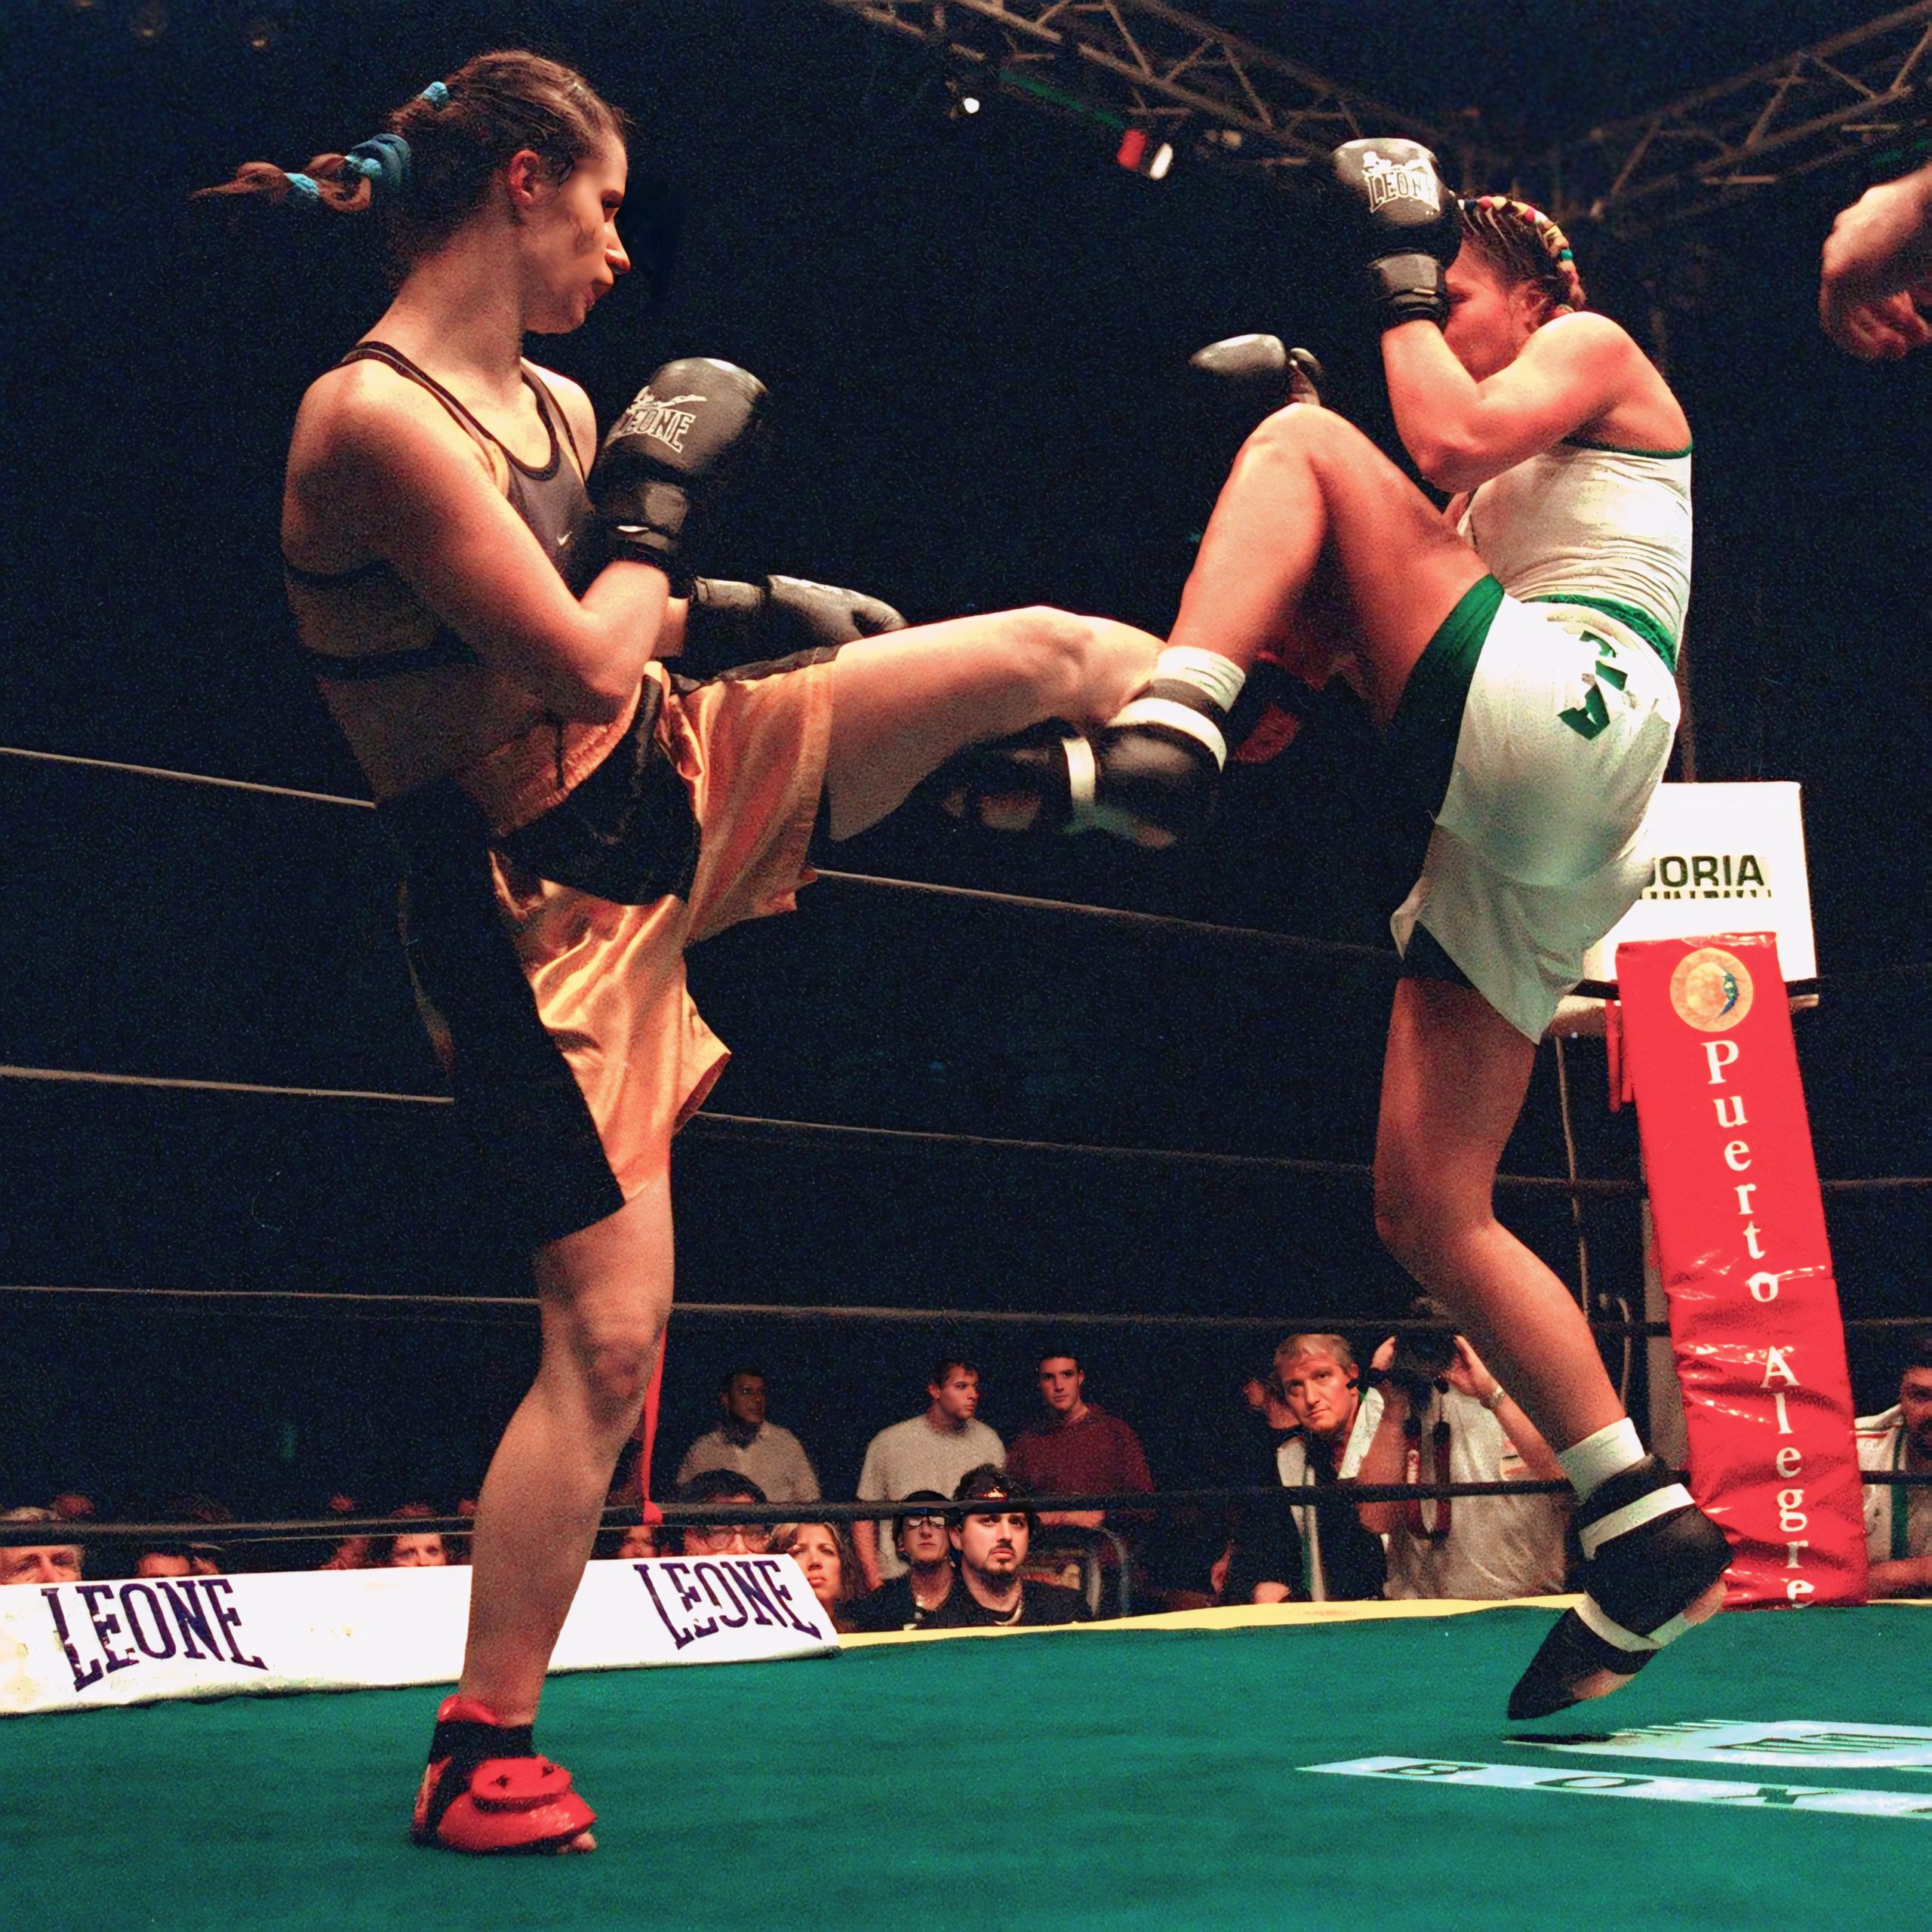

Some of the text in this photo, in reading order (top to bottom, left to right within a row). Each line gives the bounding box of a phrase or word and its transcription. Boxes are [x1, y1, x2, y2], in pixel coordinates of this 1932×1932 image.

[1649, 854, 1764, 888] ORIA
[1701, 1039, 1815, 1608] Puerto Alegre
[41, 1579, 269, 1692] LEONE
[633, 1559, 823, 1651] LEONE
